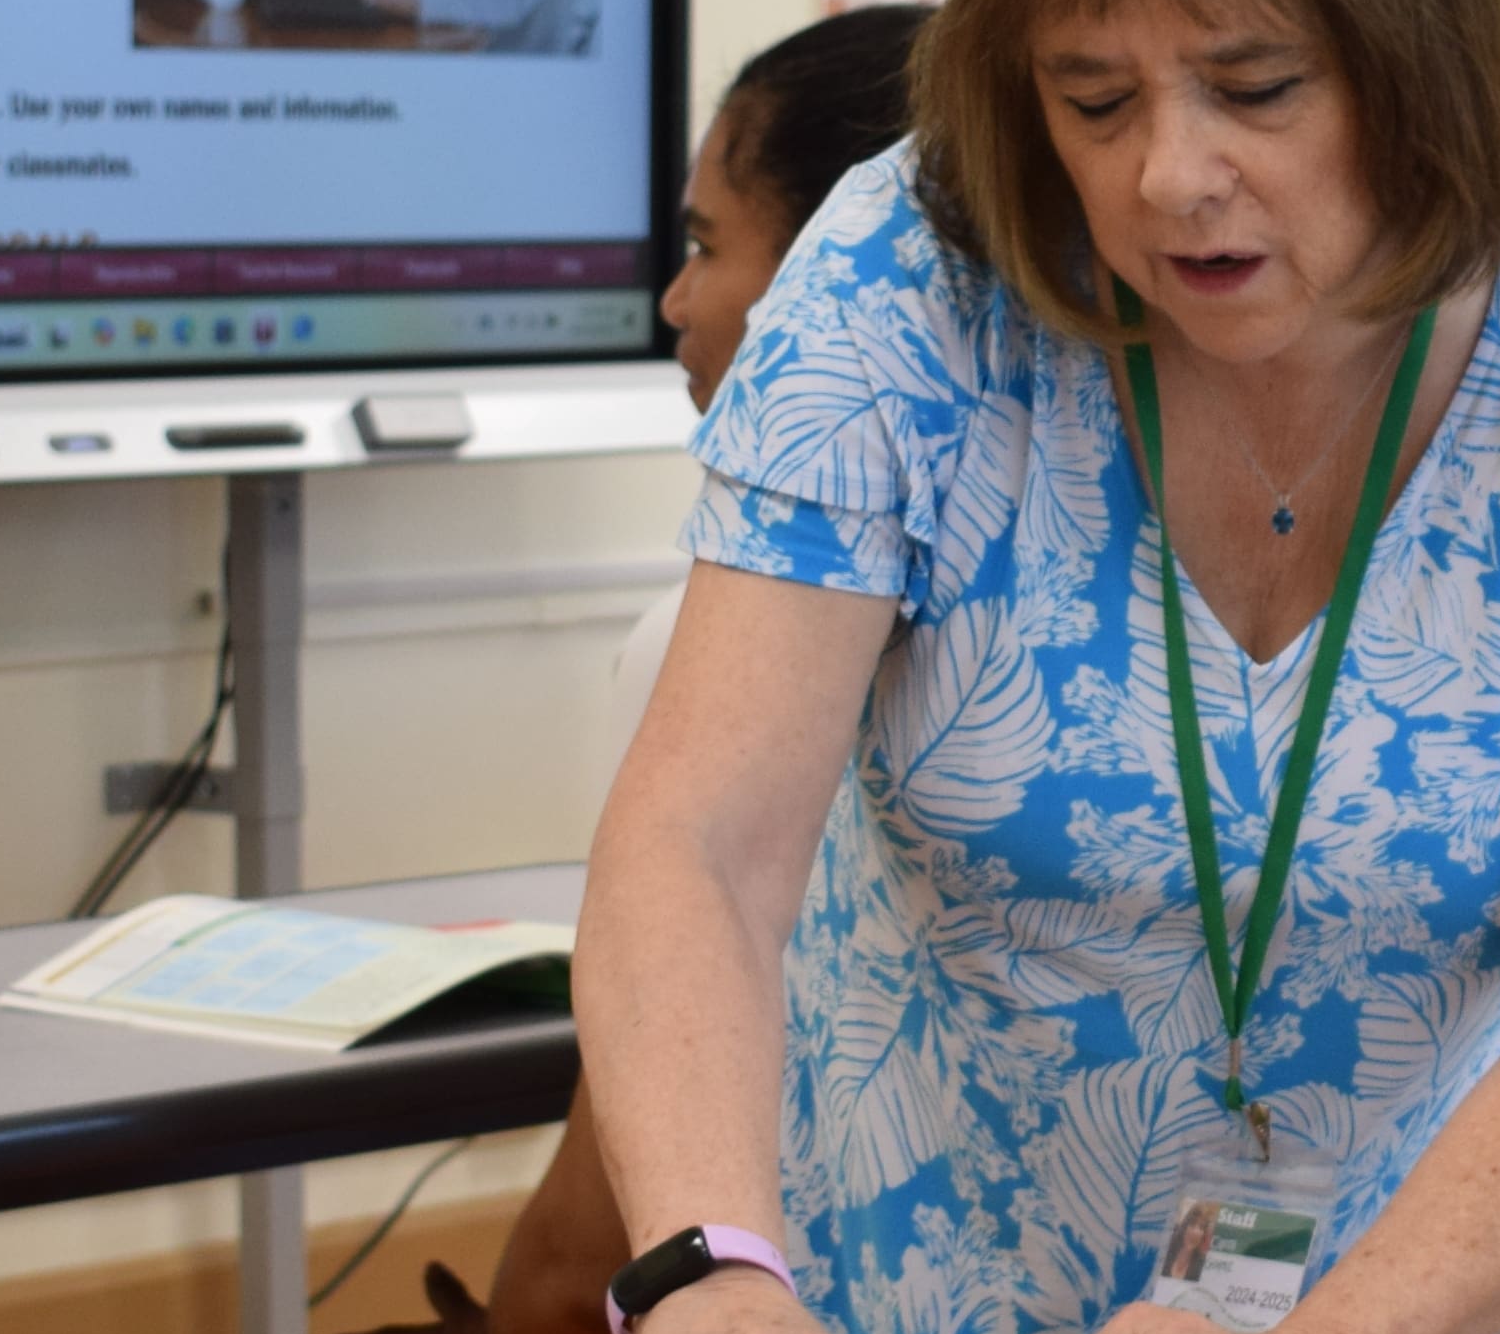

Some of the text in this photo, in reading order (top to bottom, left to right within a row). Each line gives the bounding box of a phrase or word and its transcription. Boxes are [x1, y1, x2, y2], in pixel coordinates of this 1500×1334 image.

[10, 91, 48, 120] Use
[59, 96, 104, 126] your
[112, 98, 155, 122] own
[163, 97, 231, 121] names
[238, 93, 276, 122] and
[282, 93, 401, 123] information.
[7, 151, 136, 182] classmates.
[1218, 1208, 1258, 1230] Staff
[1224, 1286, 1293, 1312] 2024-2025
